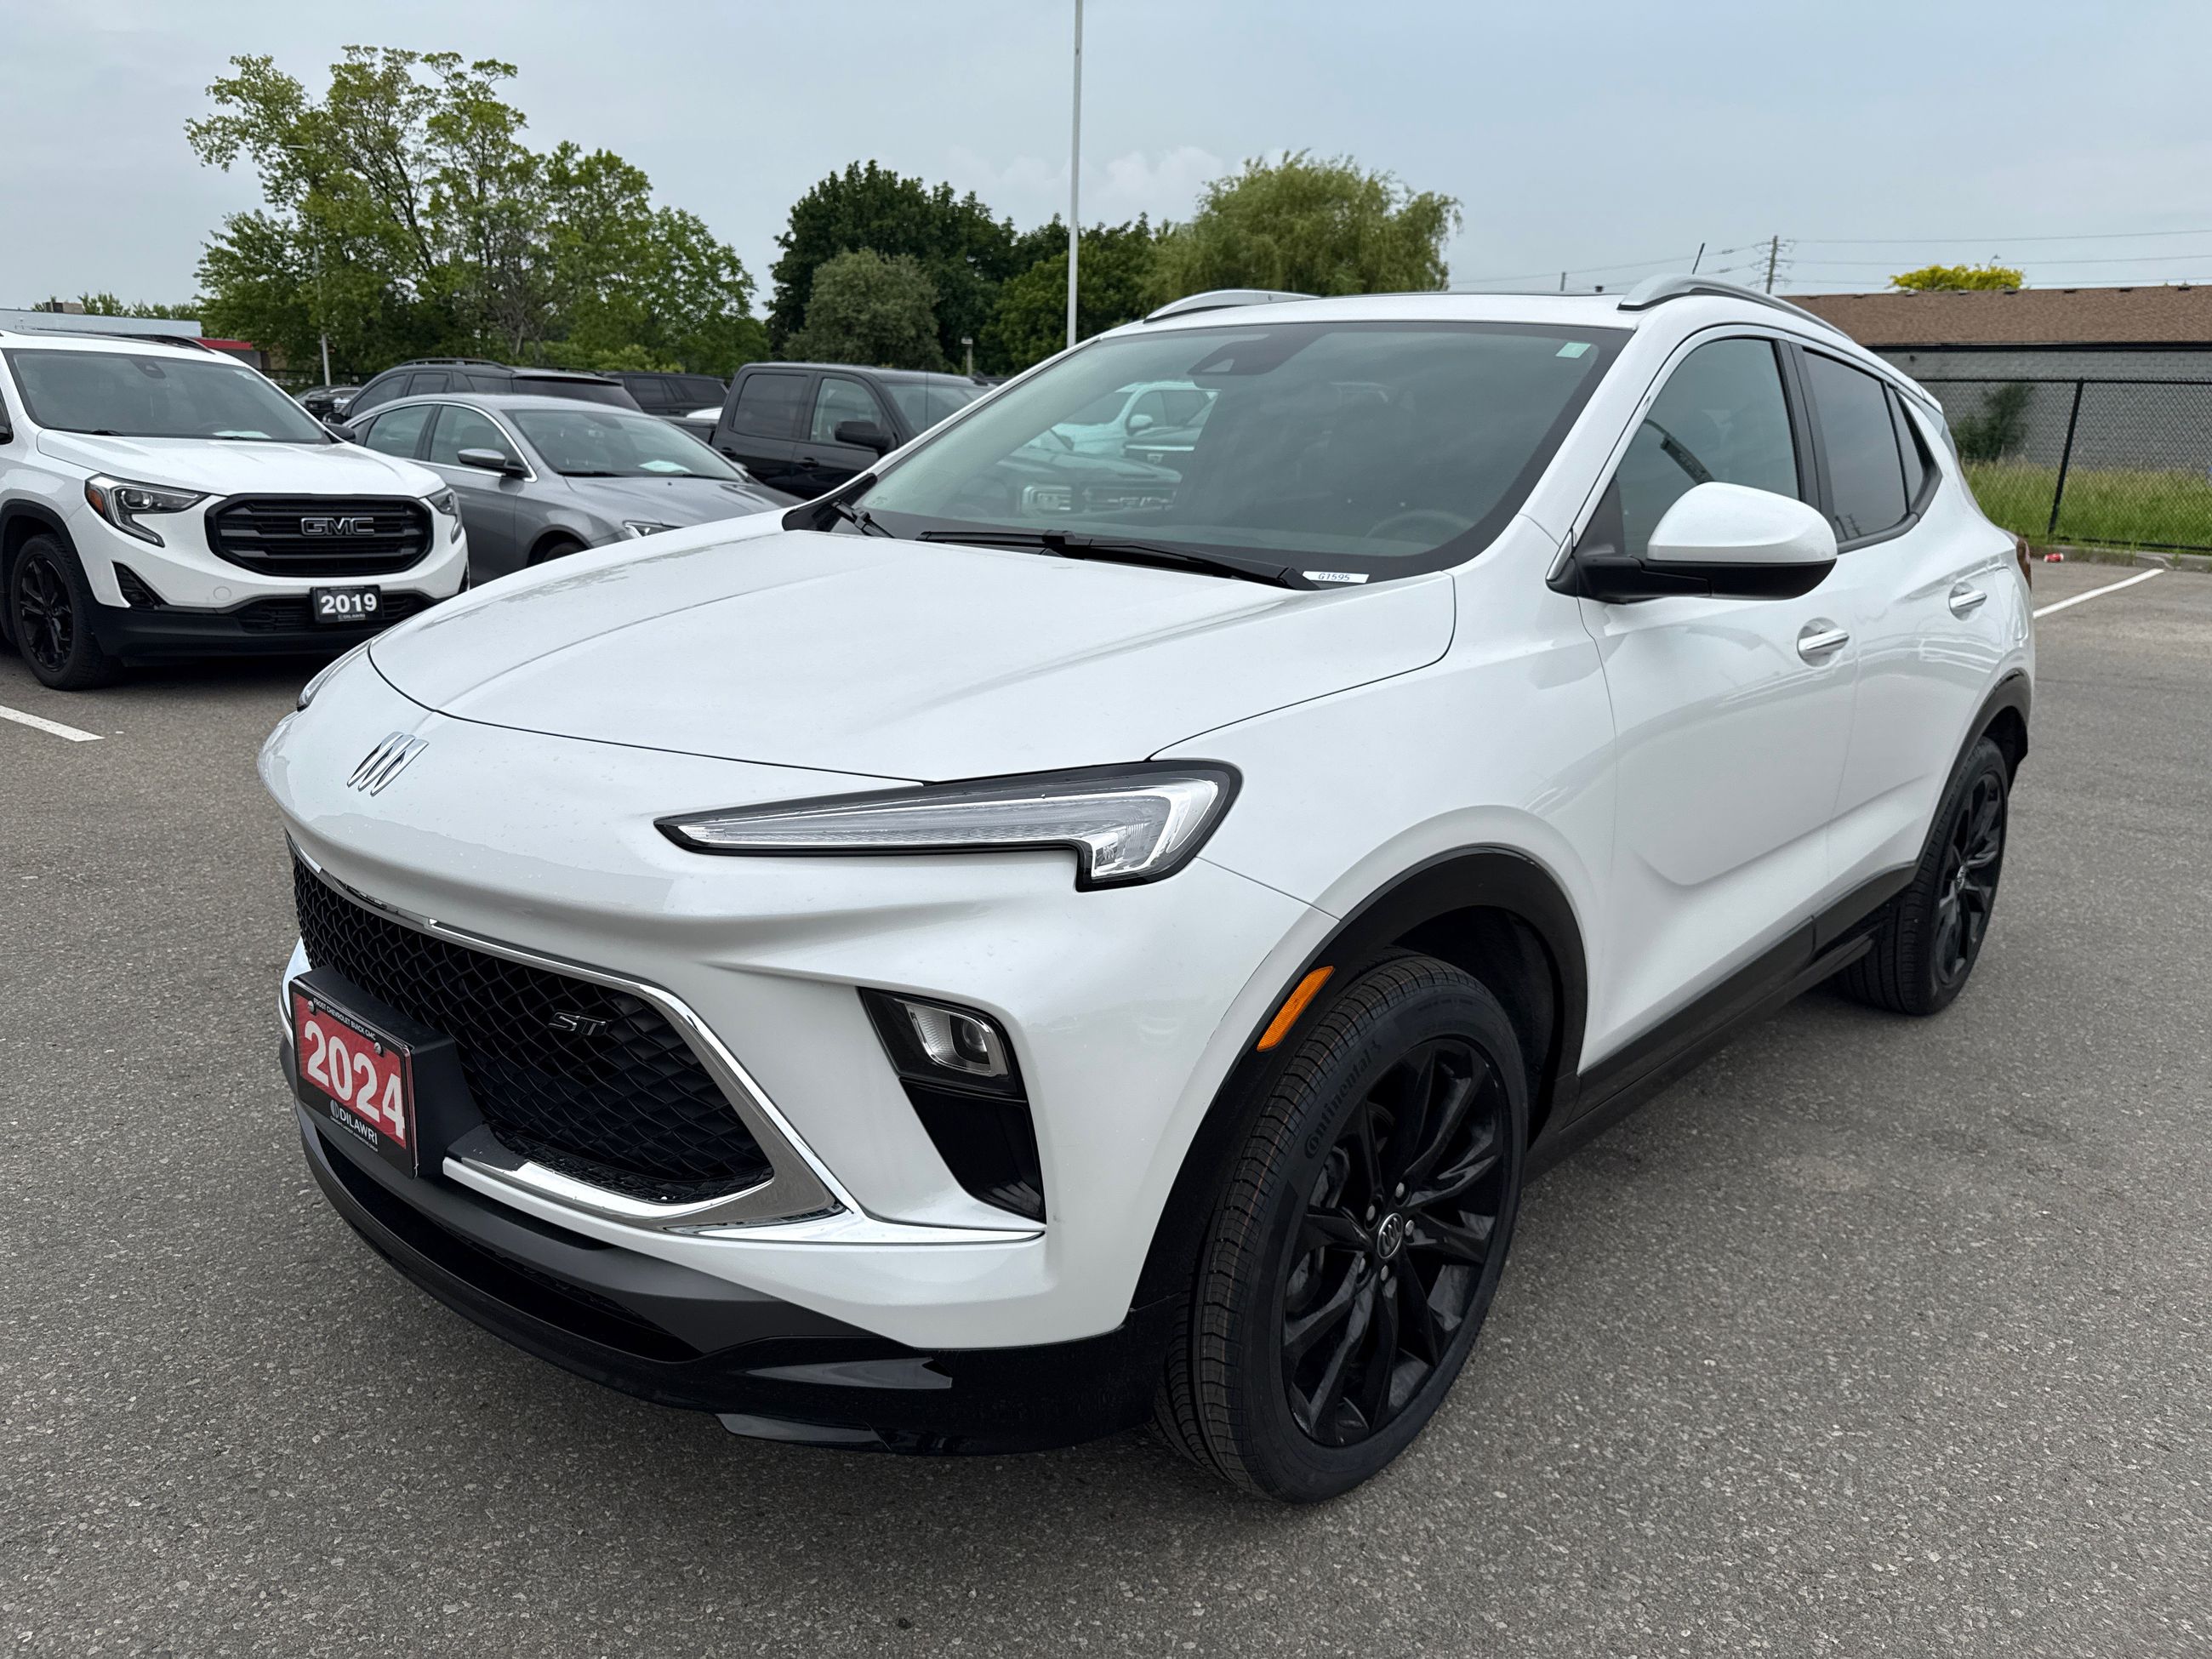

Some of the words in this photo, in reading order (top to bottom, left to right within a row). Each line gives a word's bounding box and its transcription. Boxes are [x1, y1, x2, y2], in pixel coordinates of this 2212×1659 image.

[301, 517, 374, 535] GMC
[1318, 573, 1350, 581] G1595
[321, 593, 377, 613] 2019
[548, 1012, 607, 1036] ST
[305, 1020, 405, 1140] 2024
[1304, 1047, 1374, 1159] Continental
[339, 1107, 378, 1145] DILAWRI
